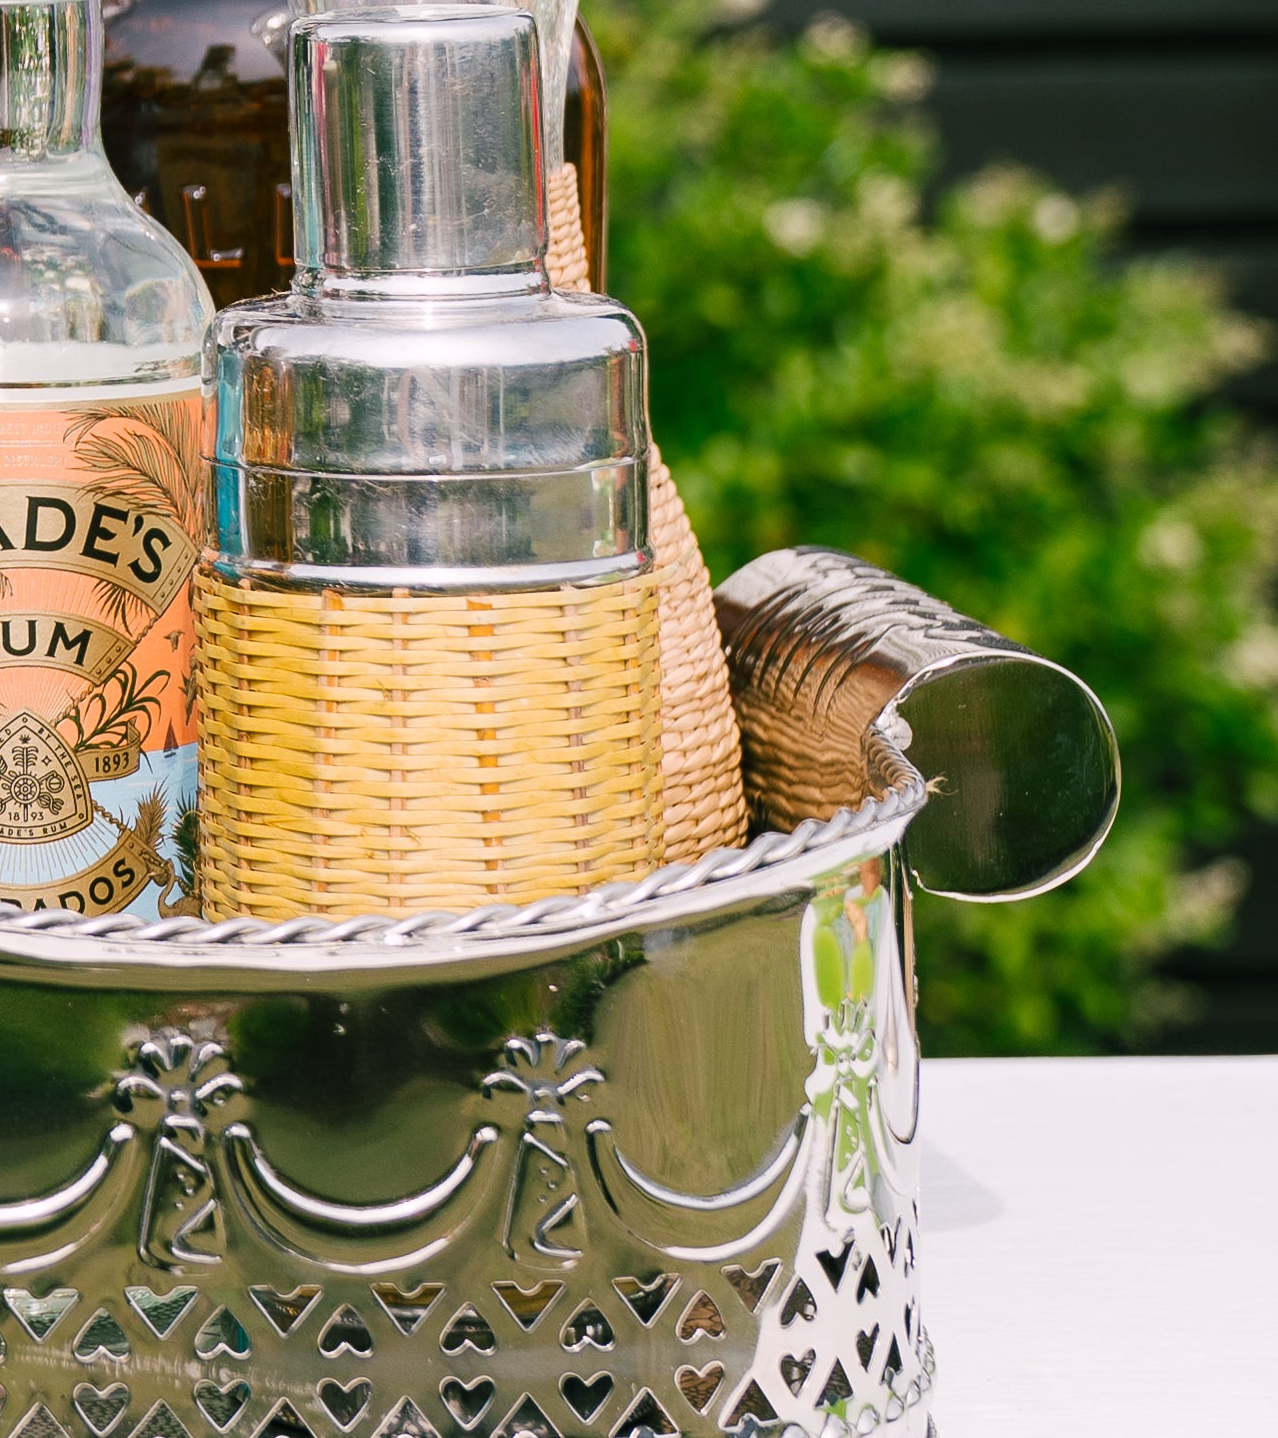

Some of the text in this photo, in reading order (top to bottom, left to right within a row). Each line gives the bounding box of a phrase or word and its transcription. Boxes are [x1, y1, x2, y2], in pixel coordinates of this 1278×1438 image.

[38, 726, 52, 742] BY
[53, 743, 73, 769] THE
[70, 774, 83, 801] SEA
[95, 752, 130, 774] 1893
[42, 821, 70, 836] RUM
